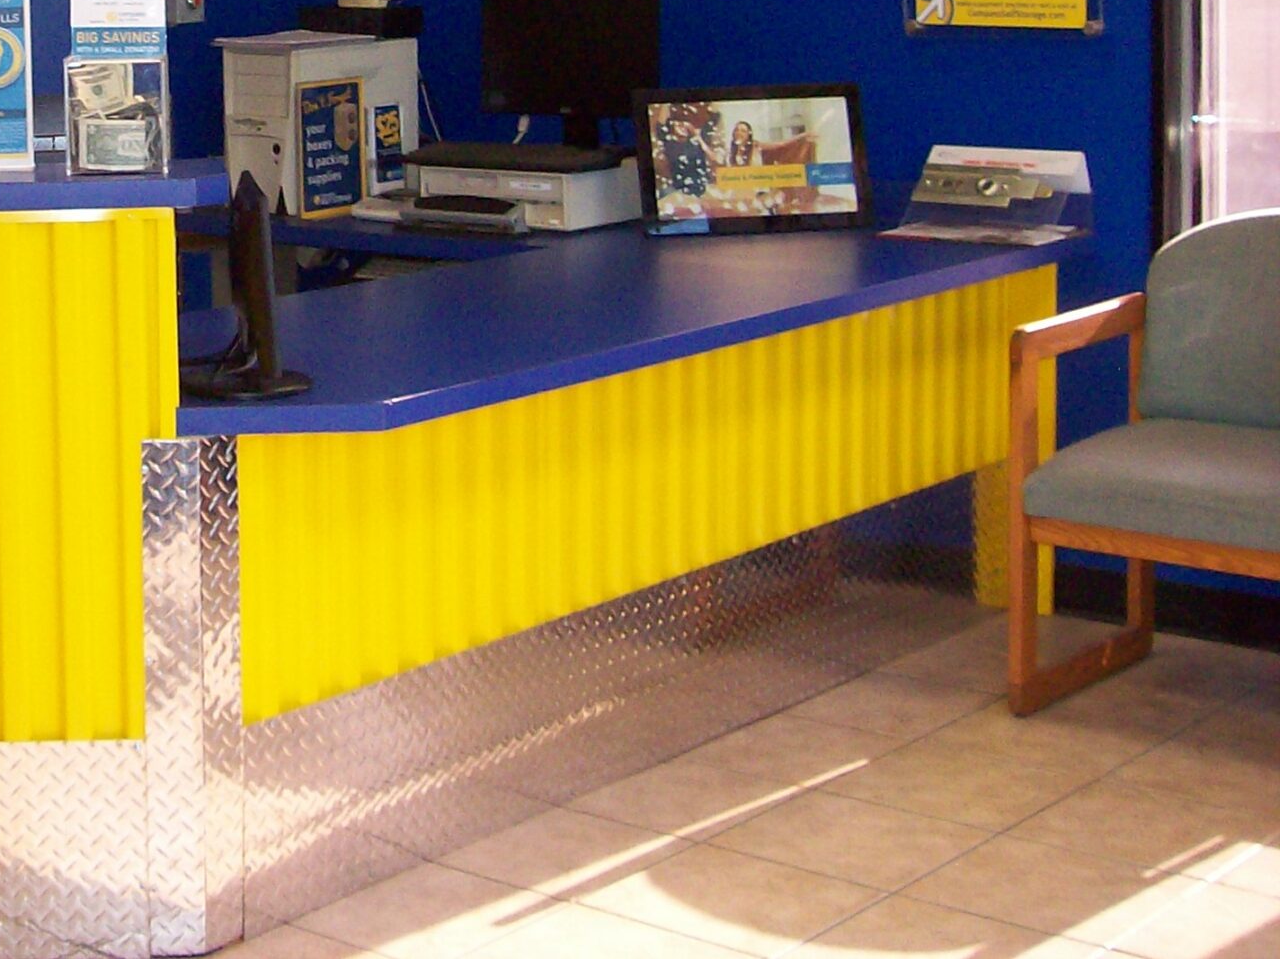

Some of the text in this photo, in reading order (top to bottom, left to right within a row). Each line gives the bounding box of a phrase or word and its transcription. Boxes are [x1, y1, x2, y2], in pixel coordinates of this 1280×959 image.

[0, 12, 20, 23] LLS
[76, 31, 160, 44] BIG SAVINGS
